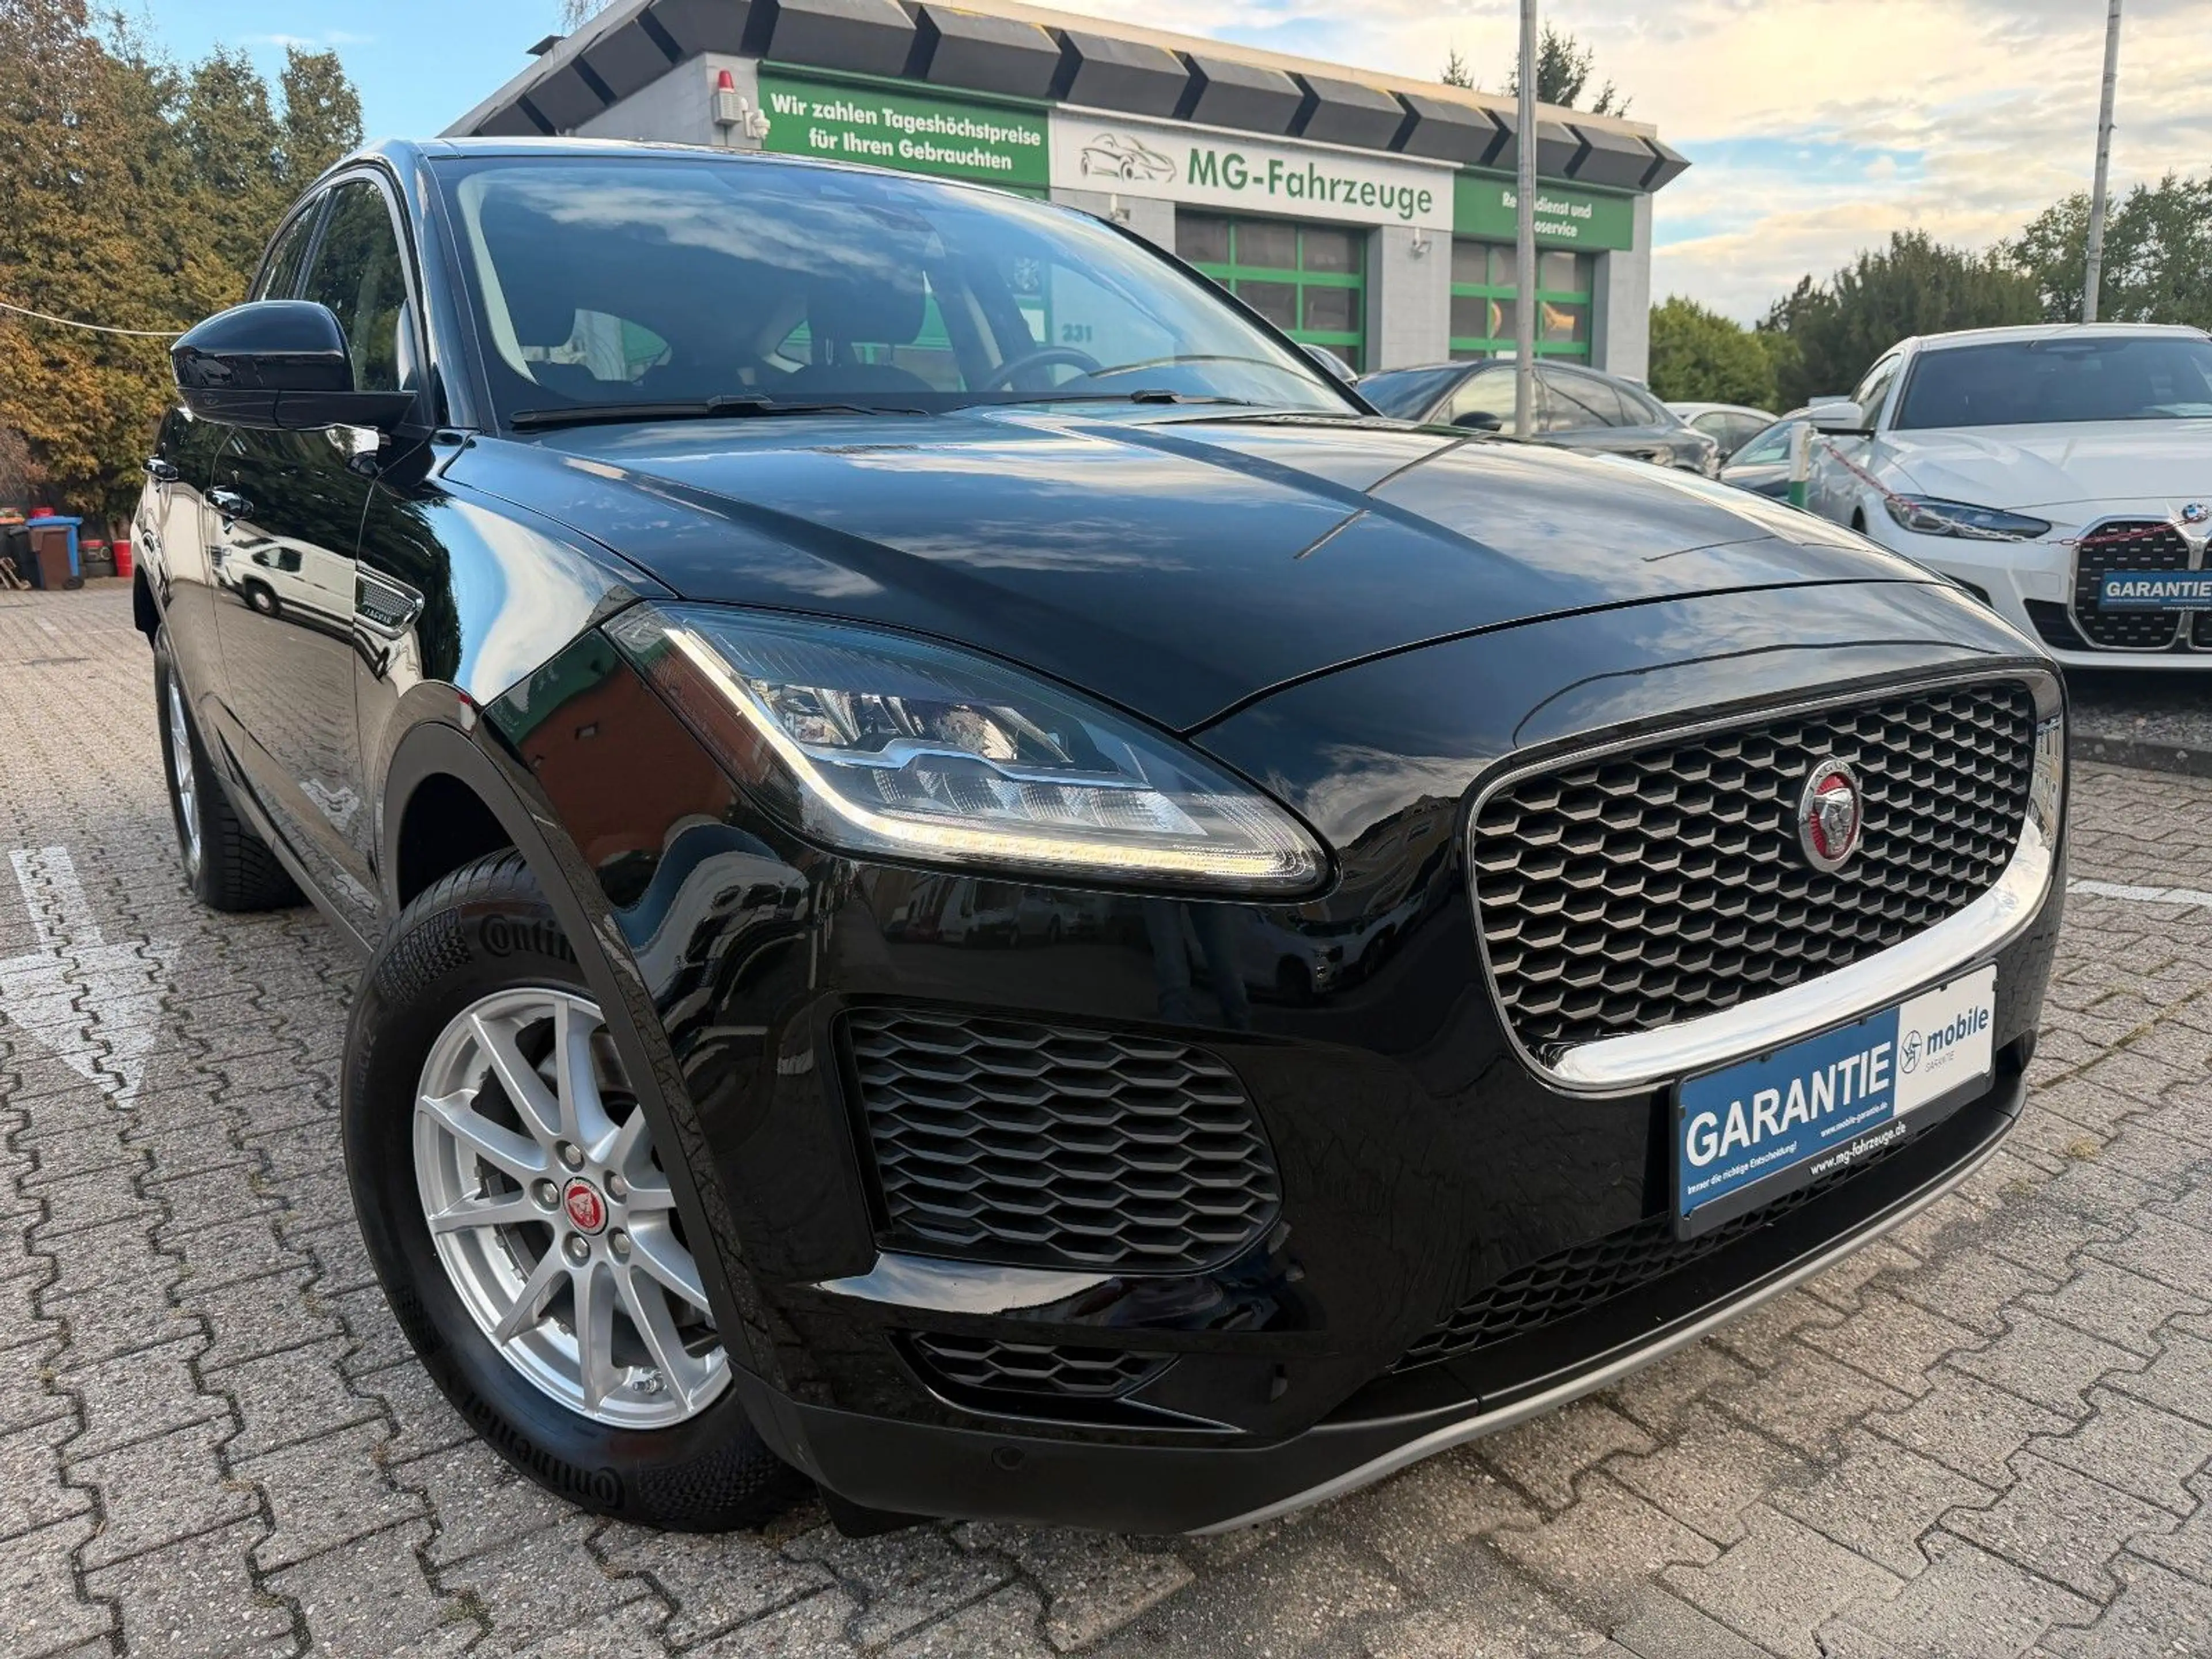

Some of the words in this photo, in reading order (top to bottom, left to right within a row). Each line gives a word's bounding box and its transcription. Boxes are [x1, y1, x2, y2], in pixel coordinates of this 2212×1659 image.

[770, 93, 808, 116] Wir
[811, 101, 878, 125] zahlen
[881, 107, 1041, 146] Tageshöchstpreise
[809, 127, 839, 150] für
[843, 131, 894, 156] Ihren
[898, 138, 1013, 171] Gebrauchten
[1187, 147, 1434, 220] MG-Fahrzeuge
[1571, 203, 1593, 219] und
[2105, 582, 2212, 597] GARANTIE
[1927, 1005, 1989, 1056] mobile
[1686, 1041, 1891, 1167] GARANTIE
[1810, 1120, 1907, 1175] www.mg-fahrzeuge.de
